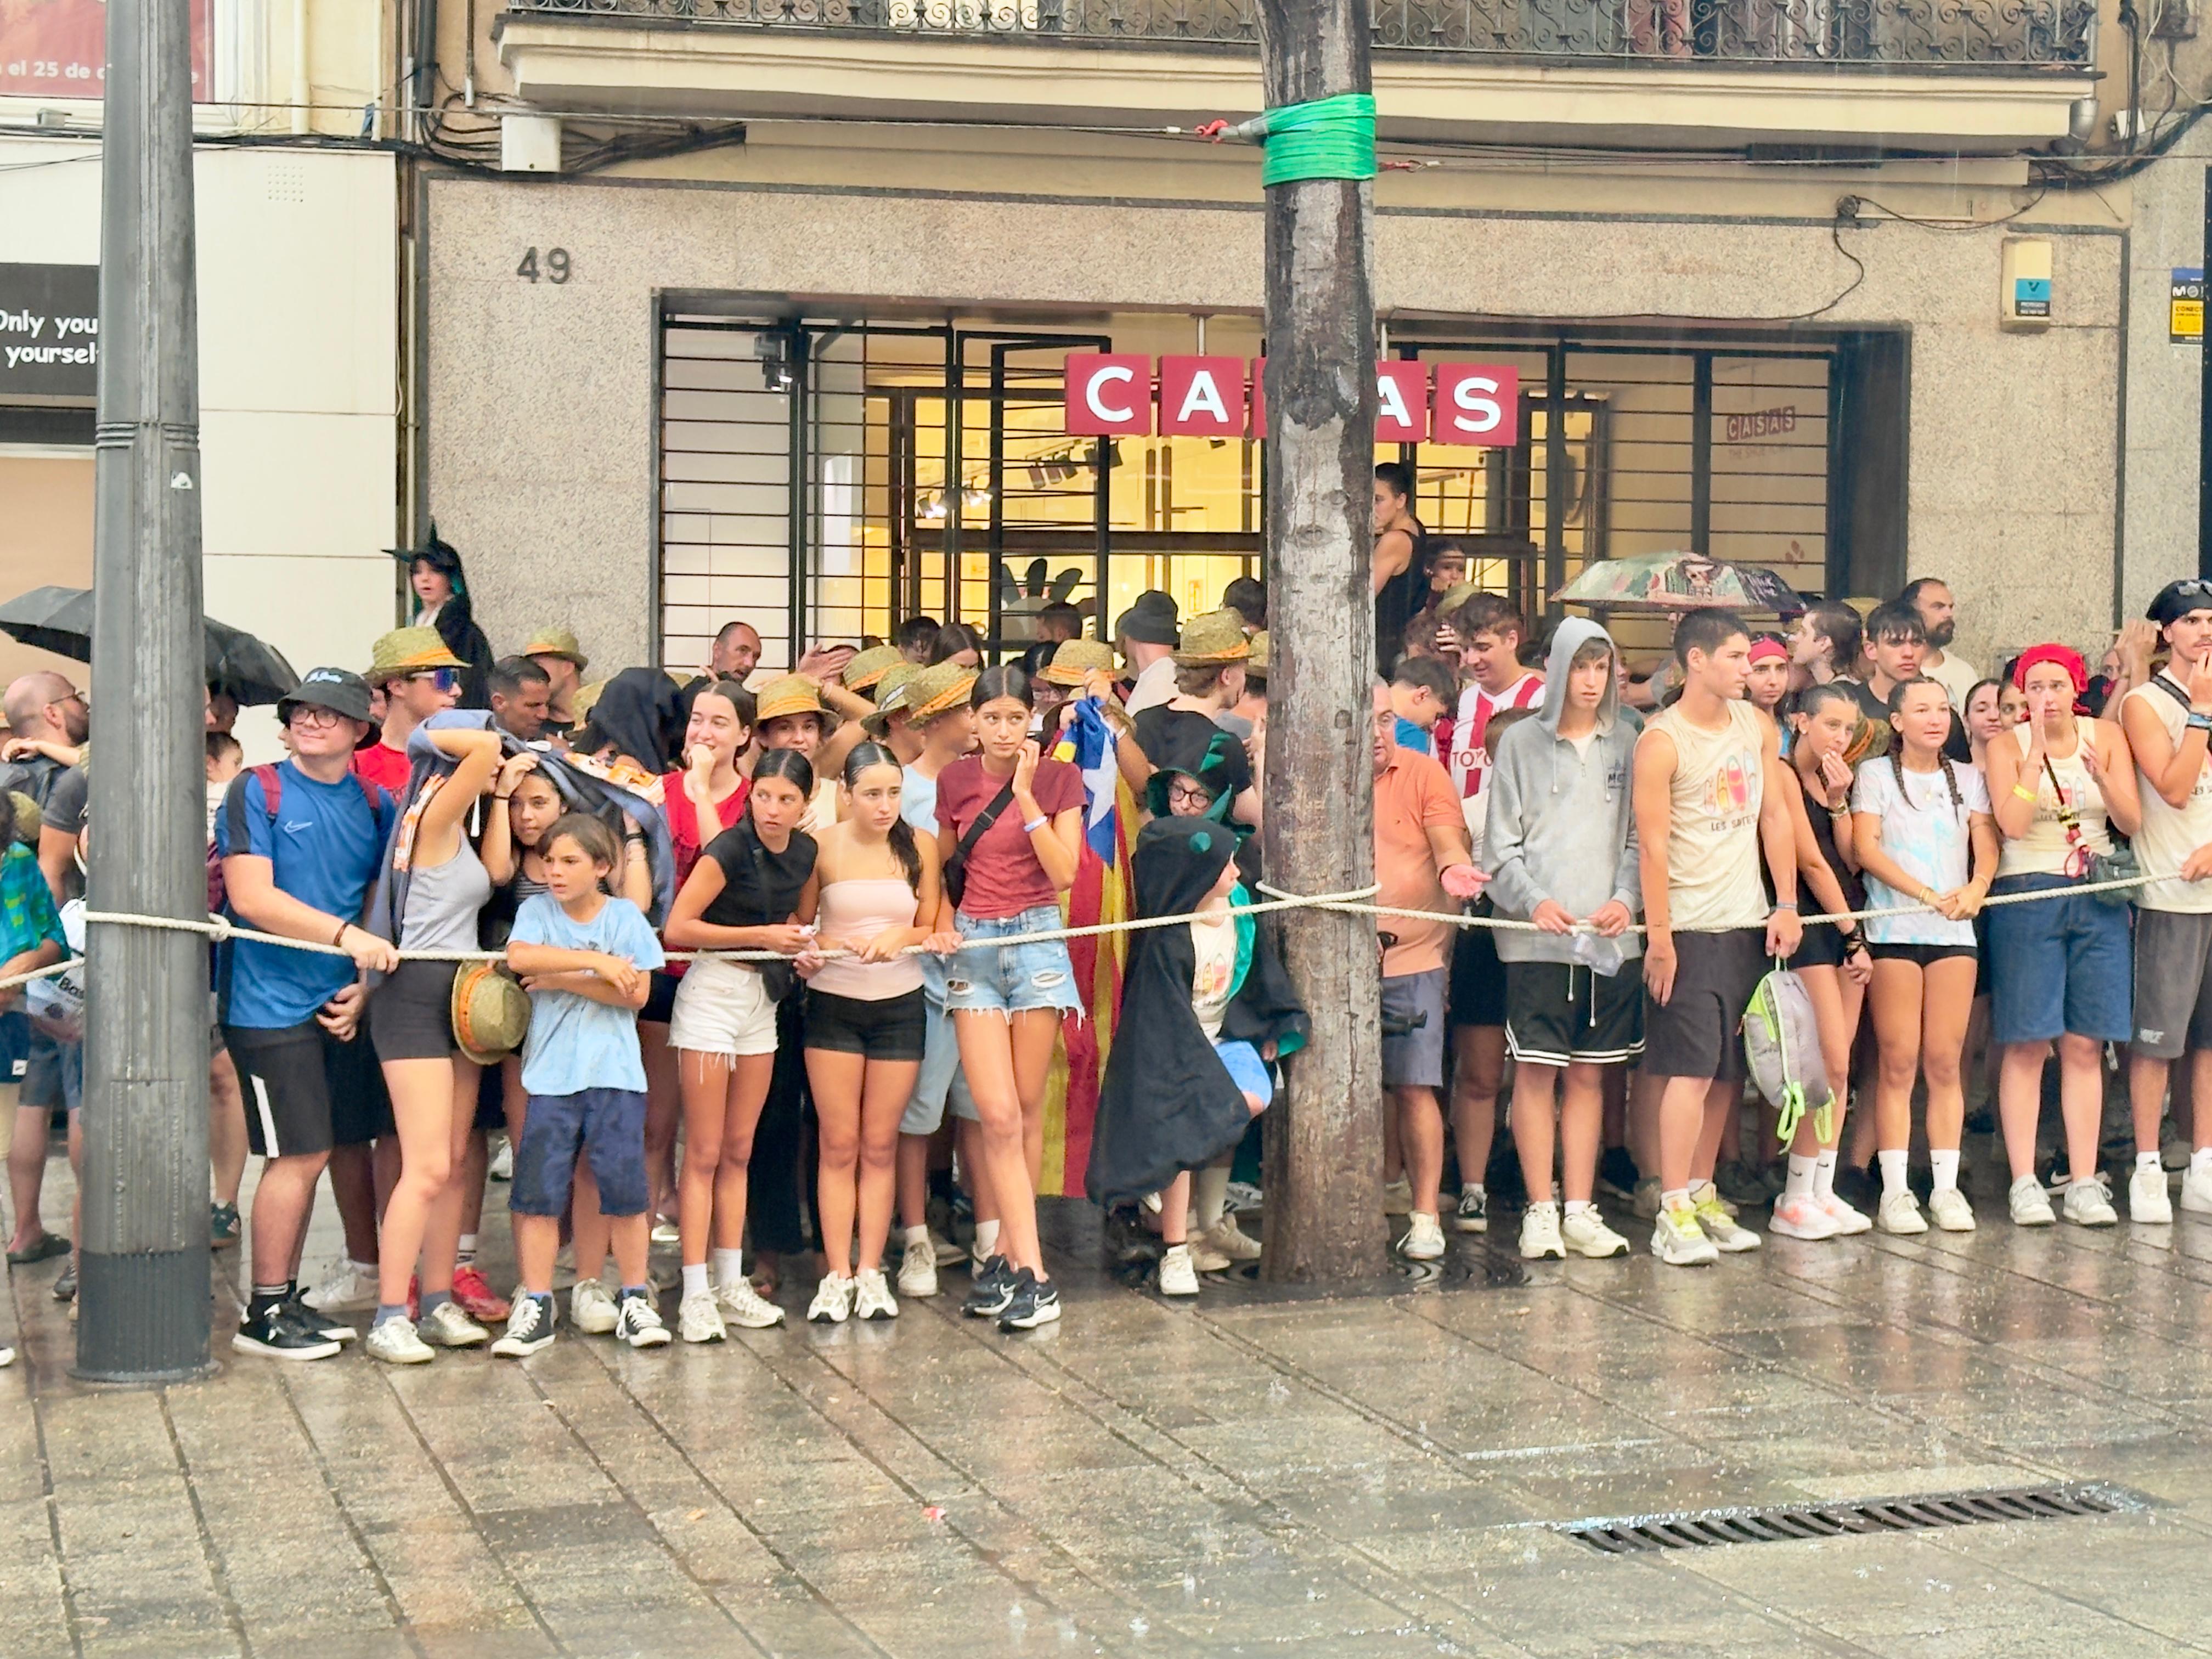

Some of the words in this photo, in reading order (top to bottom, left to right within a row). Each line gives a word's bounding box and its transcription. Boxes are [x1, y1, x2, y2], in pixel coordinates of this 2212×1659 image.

[8, 60, 27, 77] el
[33, 61, 59, 77] 25
[65, 63, 91, 79] de
[517, 246, 571, 284] 49
[0, 309, 46, 339] Only
[54, 316, 98, 340] you
[5, 341, 100, 369] yoursel
[1086, 366, 1501, 432] CAAS
[1728, 409, 1793, 438] CASAS
[1711, 821, 1726, 831] LES
